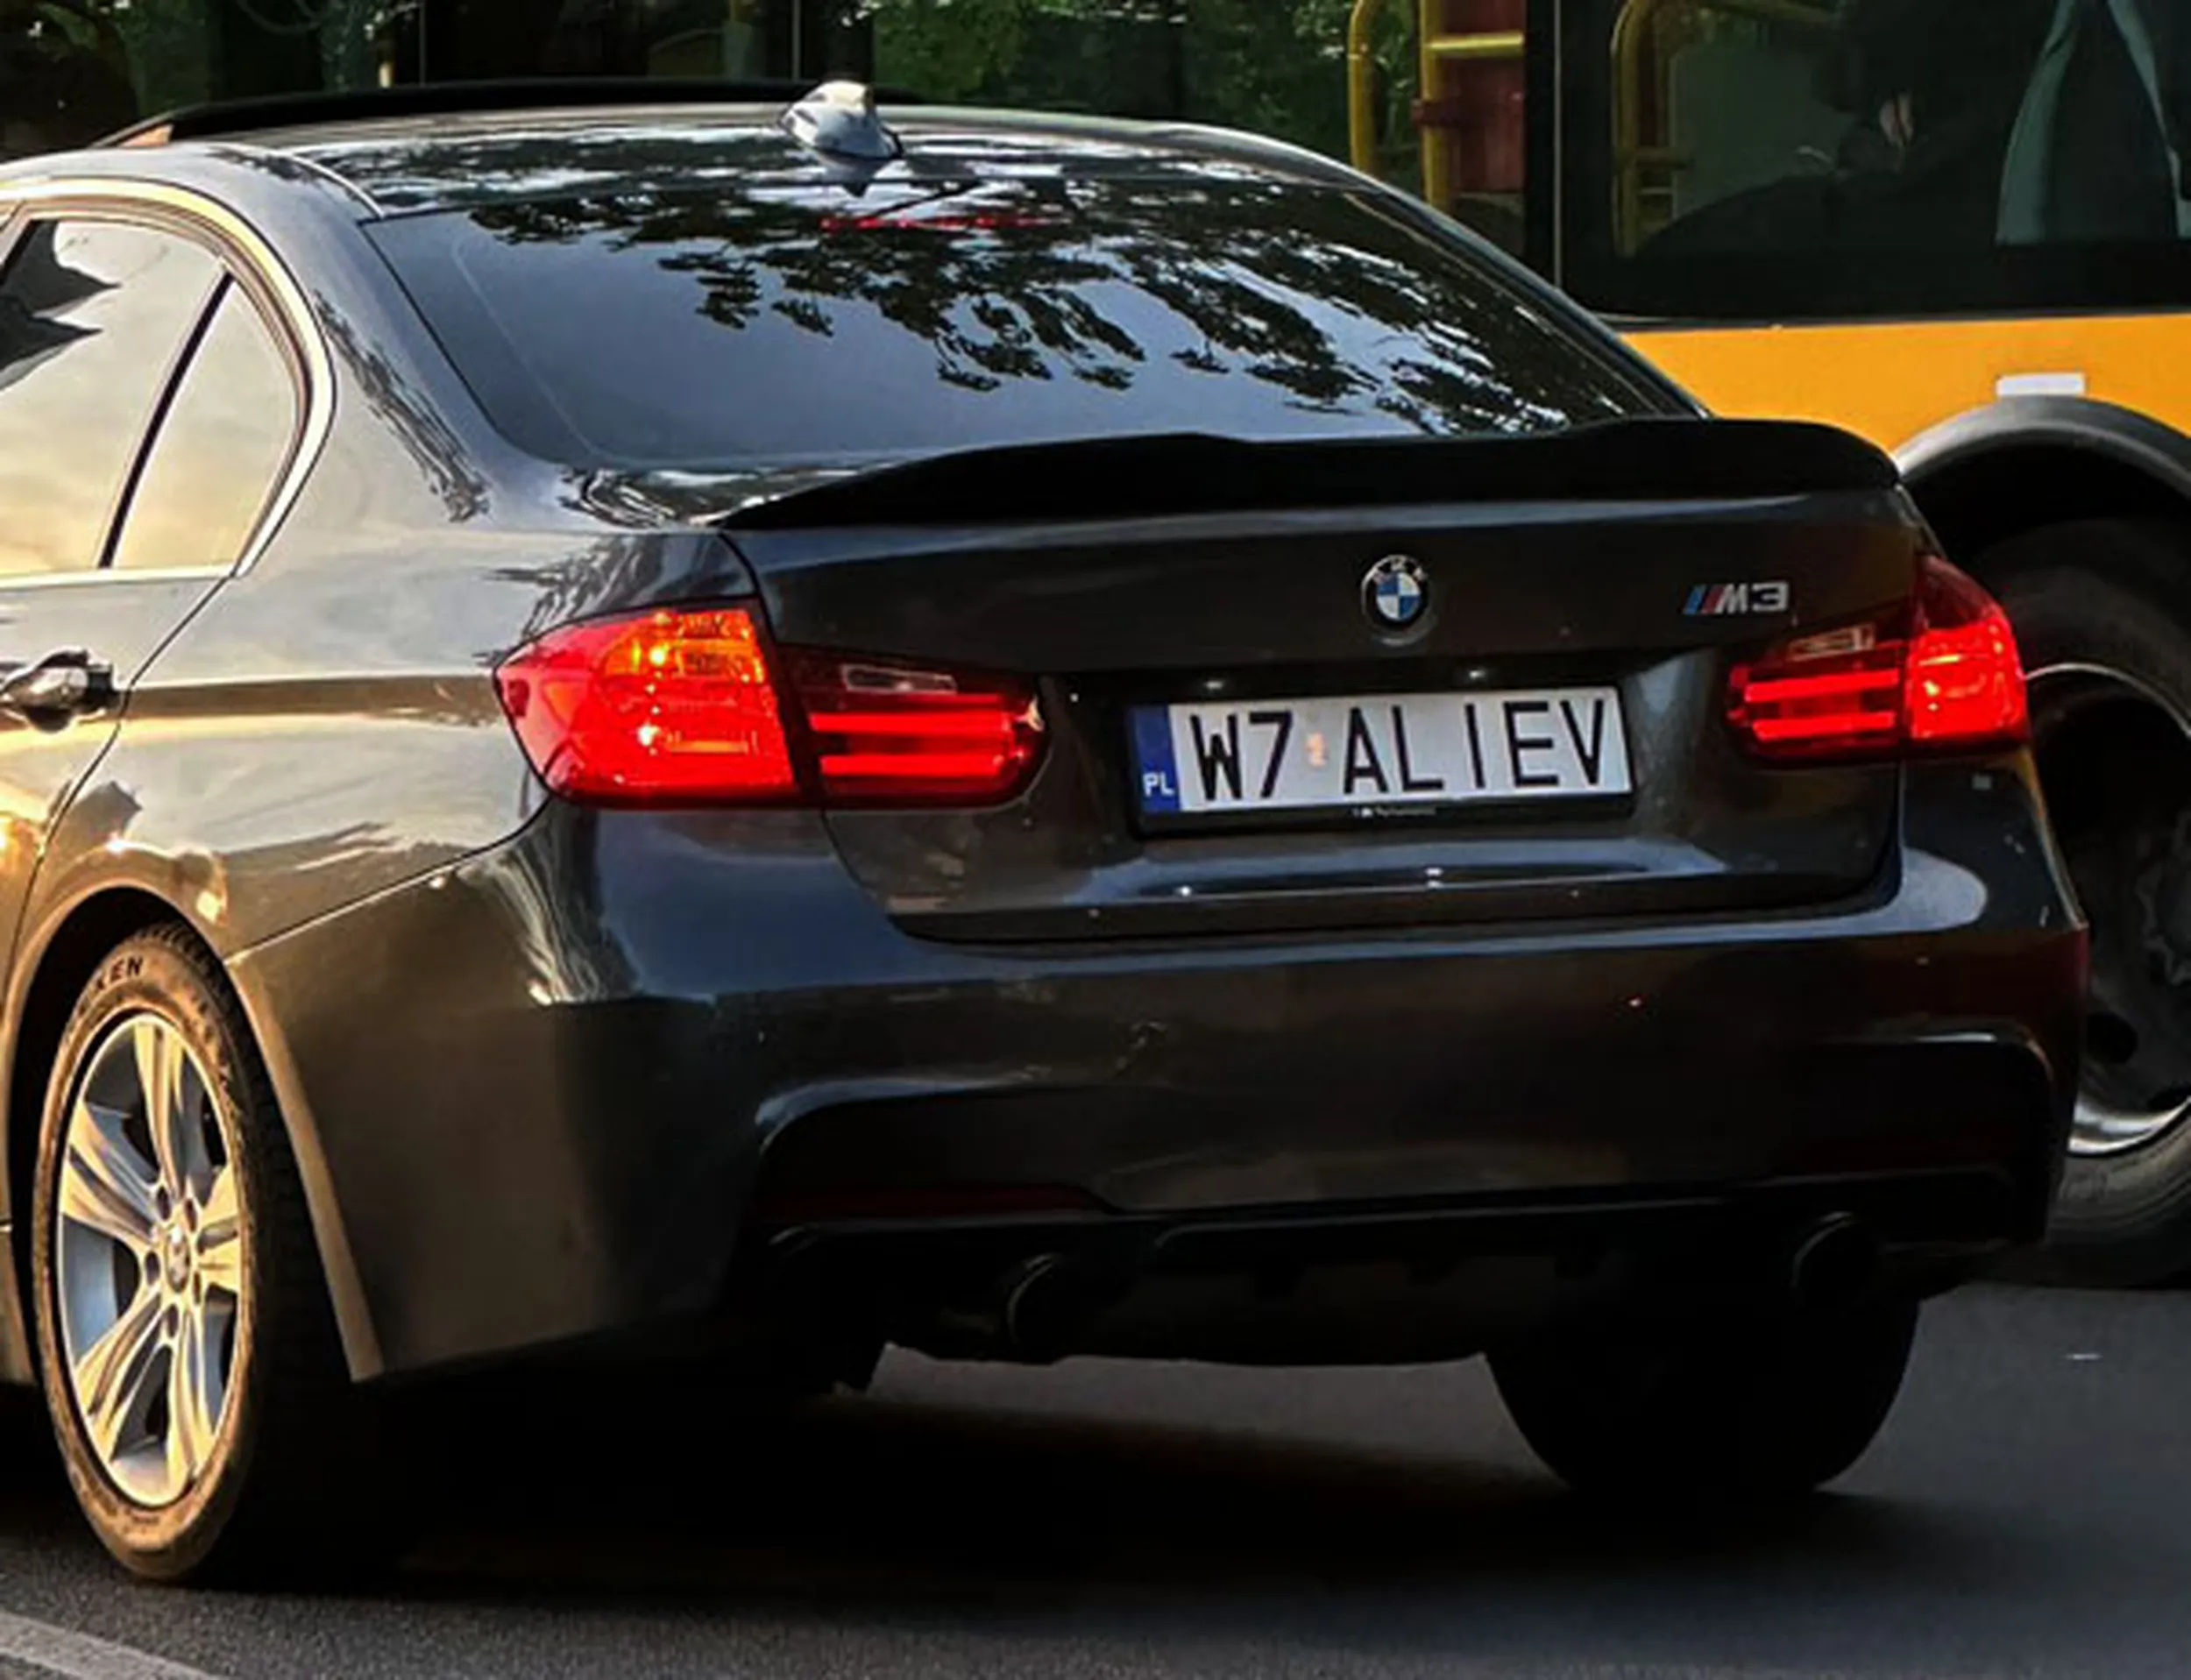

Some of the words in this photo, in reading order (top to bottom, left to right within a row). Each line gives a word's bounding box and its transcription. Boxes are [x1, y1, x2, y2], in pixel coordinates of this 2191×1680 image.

[1713, 580, 1789, 614] M3
[1189, 710, 1293, 801] W7
[1342, 698, 1605, 795] ALIEV
[1142, 771, 1175, 797] PL
